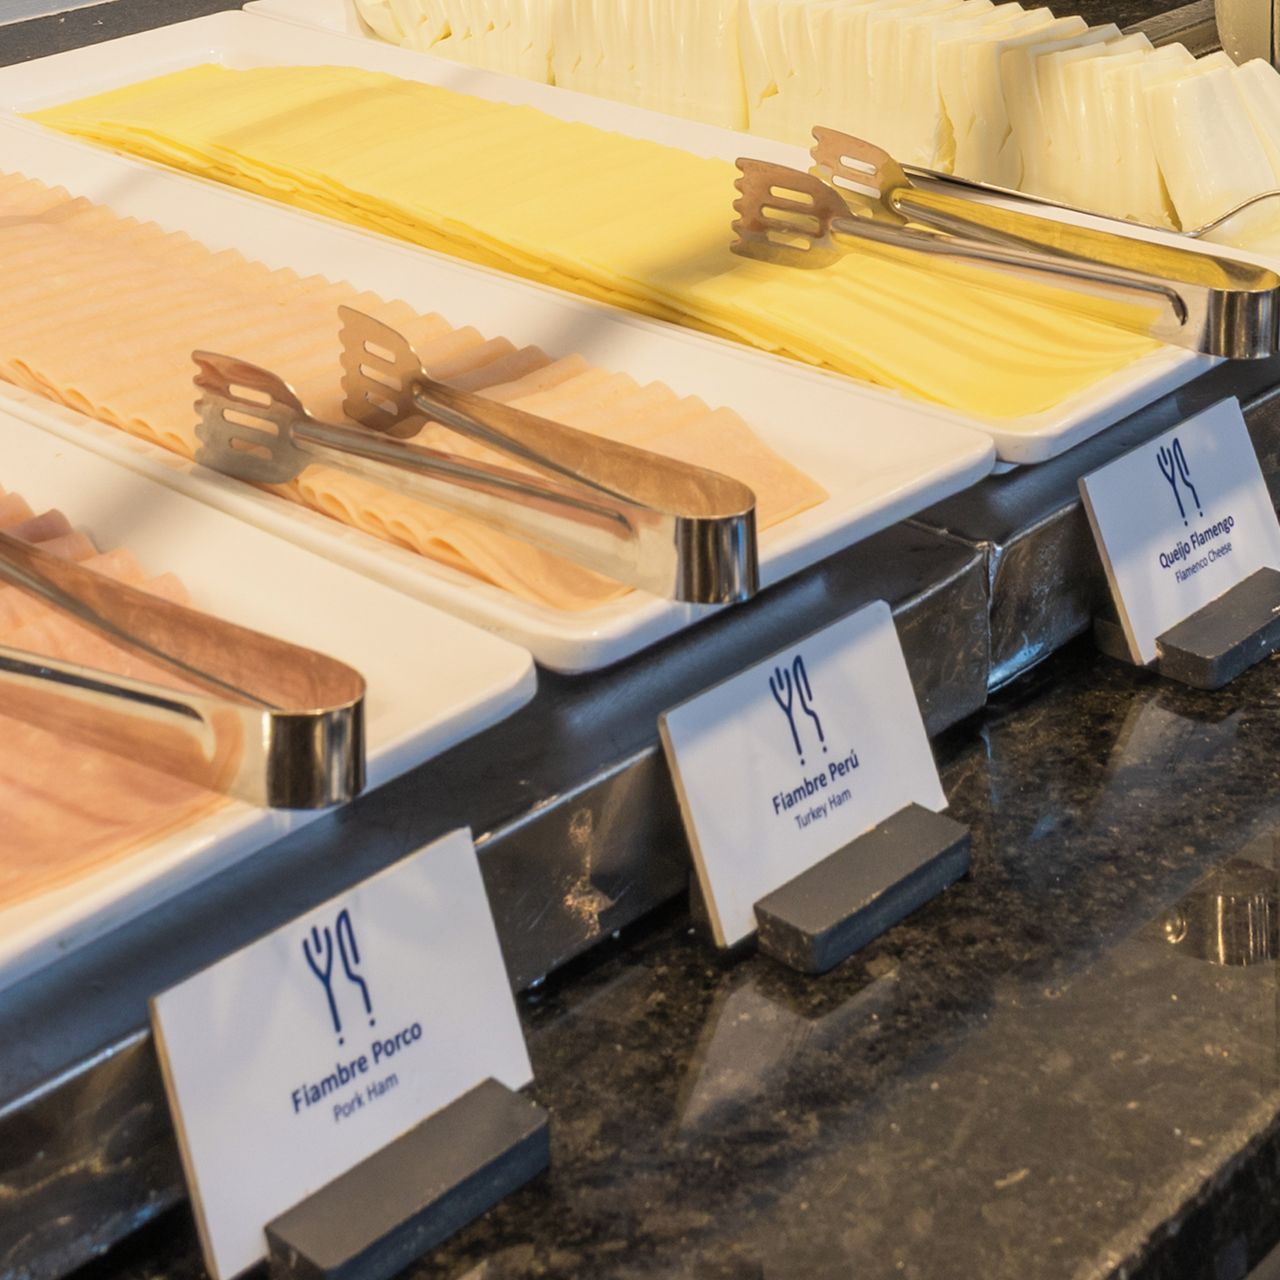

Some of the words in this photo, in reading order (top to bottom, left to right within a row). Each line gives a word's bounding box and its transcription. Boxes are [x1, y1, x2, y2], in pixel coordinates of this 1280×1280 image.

[1159, 541, 1191, 569] Queijo
[1190, 515, 1235, 550] Flamengo
[1175, 557, 1208, 583] Flamenco
[1208, 542, 1233, 563] Cheese
[772, 773, 827, 815] Fiambre
[828, 748, 859, 782] Perú
[794, 803, 827, 830] Turkey
[828, 788, 852, 811] Ham
[292, 1055, 368, 1114] Fiambre
[372, 1022, 422, 1065] Porco
[333, 1091, 365, 1122] Pork
[366, 1073, 399, 1101] Ham
